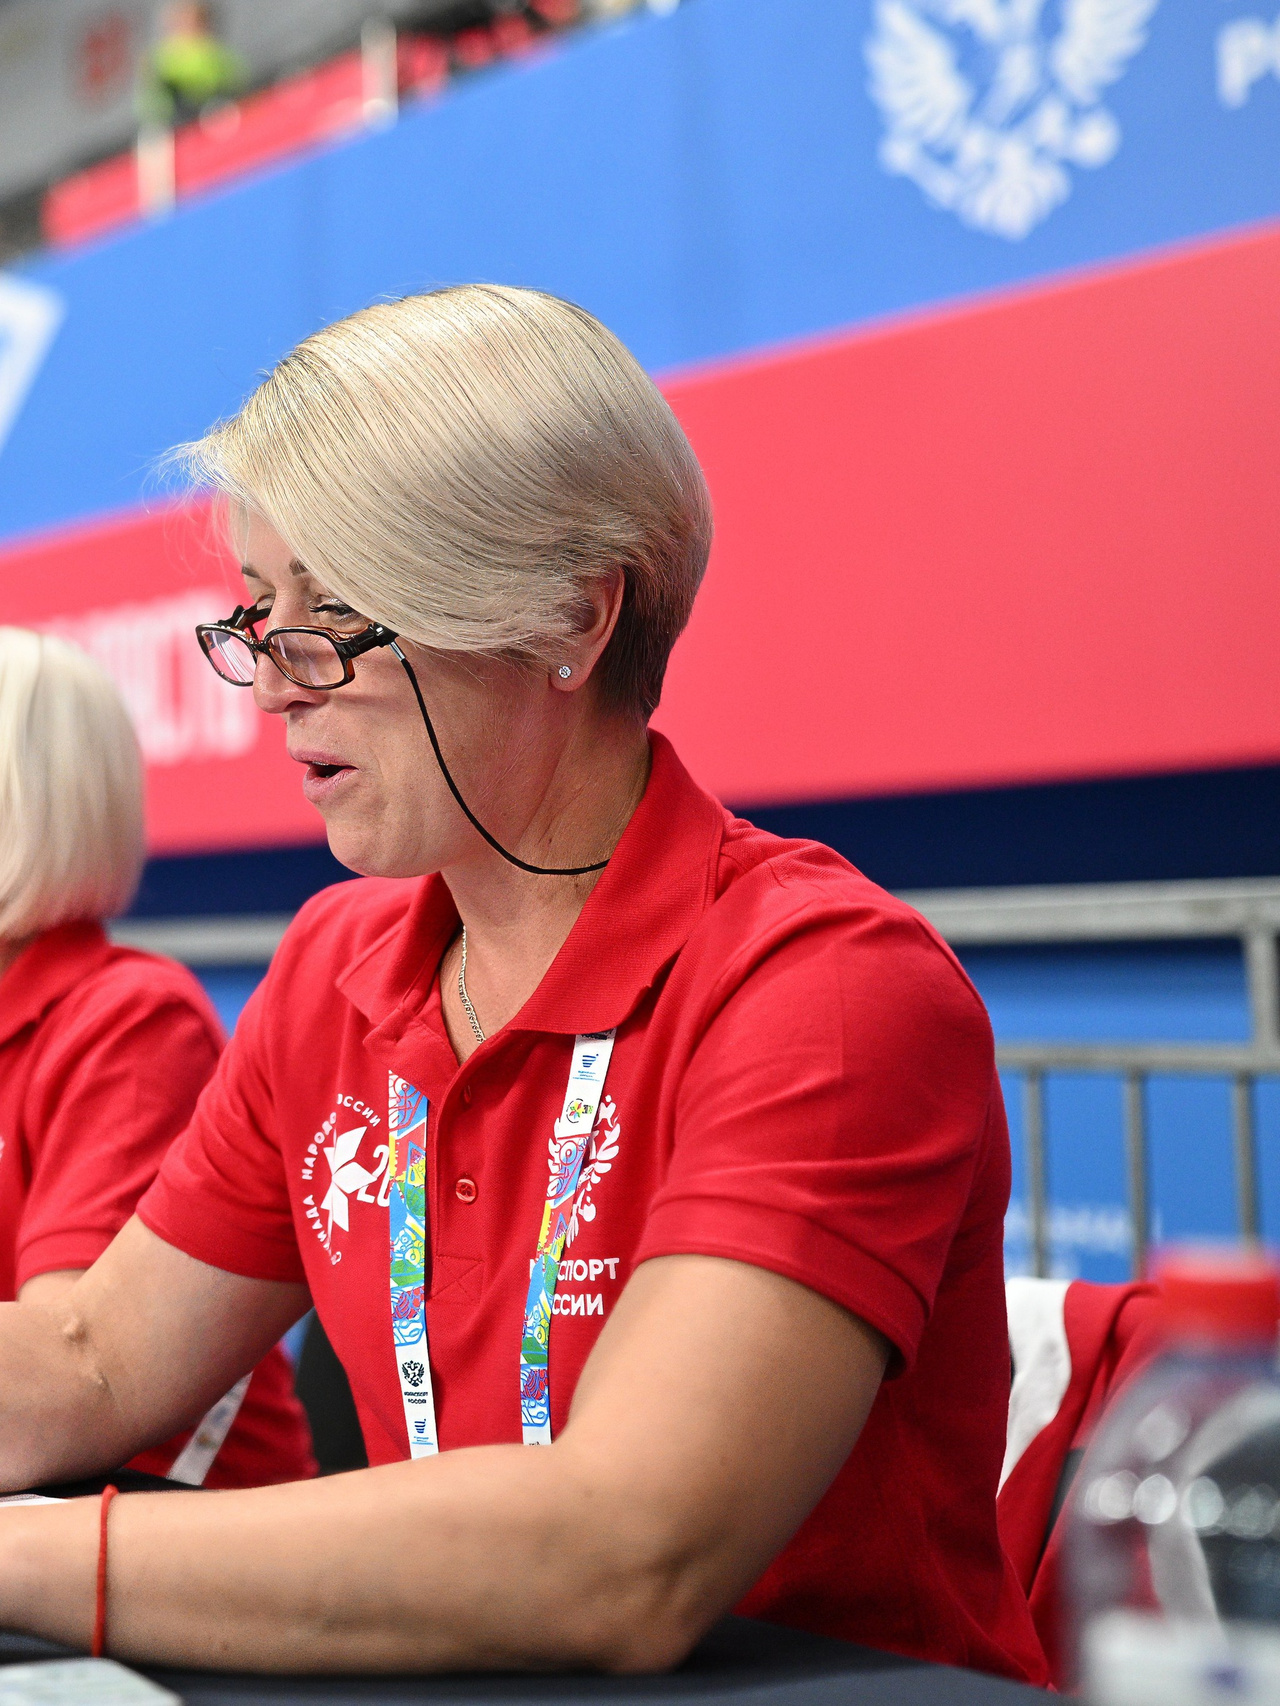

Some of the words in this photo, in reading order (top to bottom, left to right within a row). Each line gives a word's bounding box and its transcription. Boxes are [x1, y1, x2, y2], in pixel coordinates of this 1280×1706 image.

[301, 1111, 337, 1181] НАРОДО
[337, 1093, 381, 1128] ССИИ
[529, 1258, 620, 1281] СПОРТ
[551, 1293, 604, 1316] ССИИ
